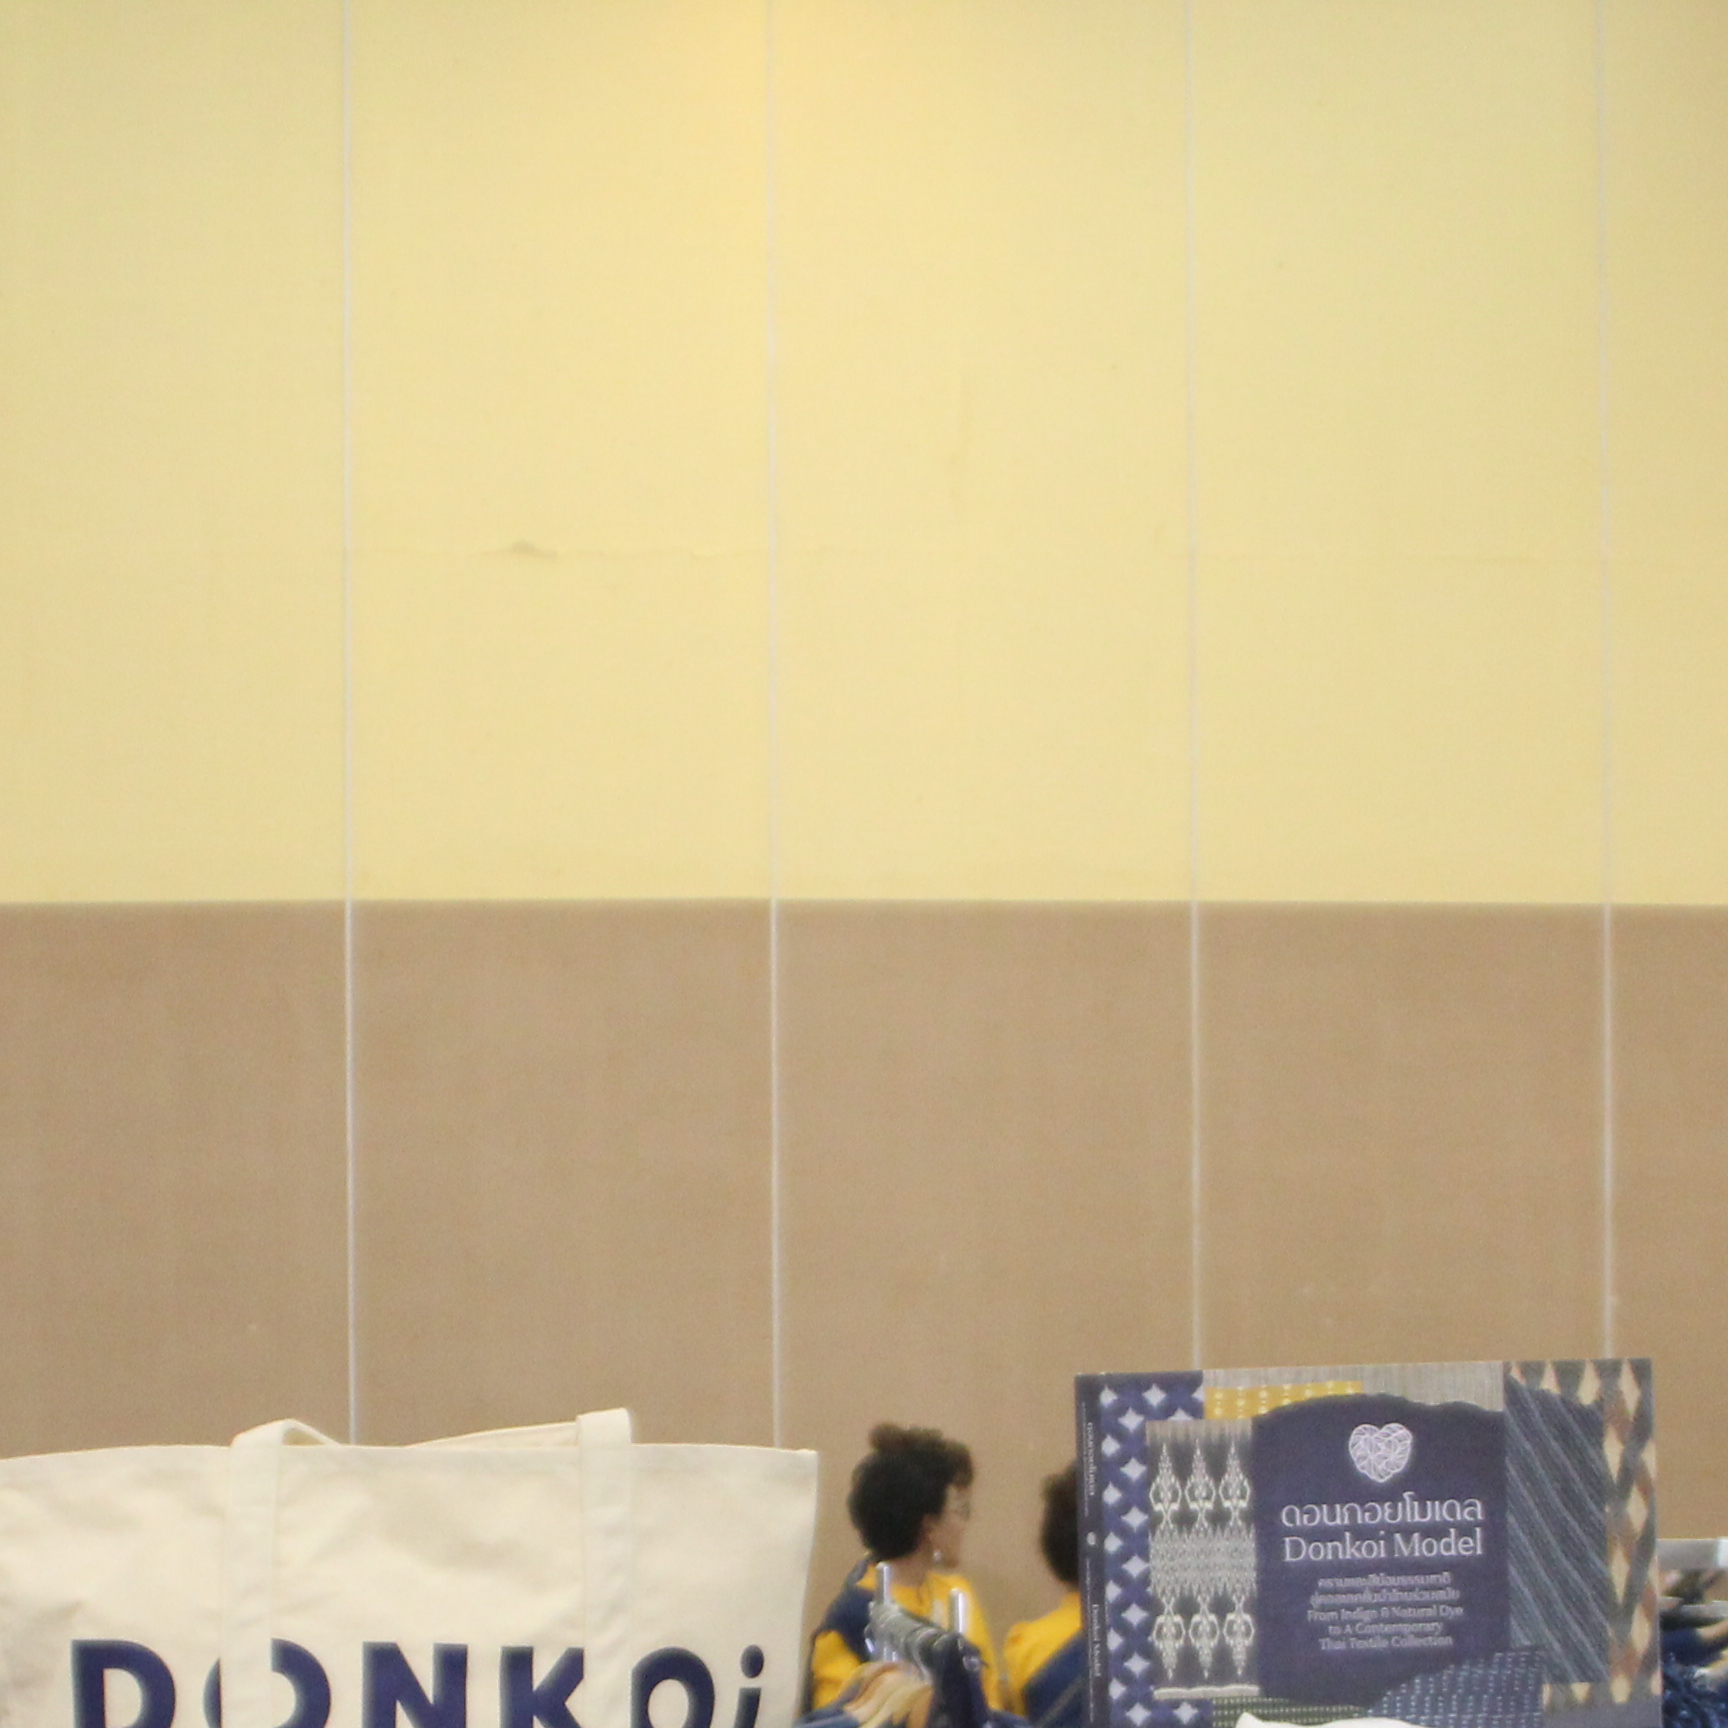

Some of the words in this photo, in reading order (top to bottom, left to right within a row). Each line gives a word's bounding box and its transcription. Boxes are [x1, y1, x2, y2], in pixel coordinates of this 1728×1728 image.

[1280, 1491, 1485, 1527] ดอนกอยโมเดล
[1283, 1530, 1387, 1562] Donkoi
[1393, 1526, 1484, 1558] Model
